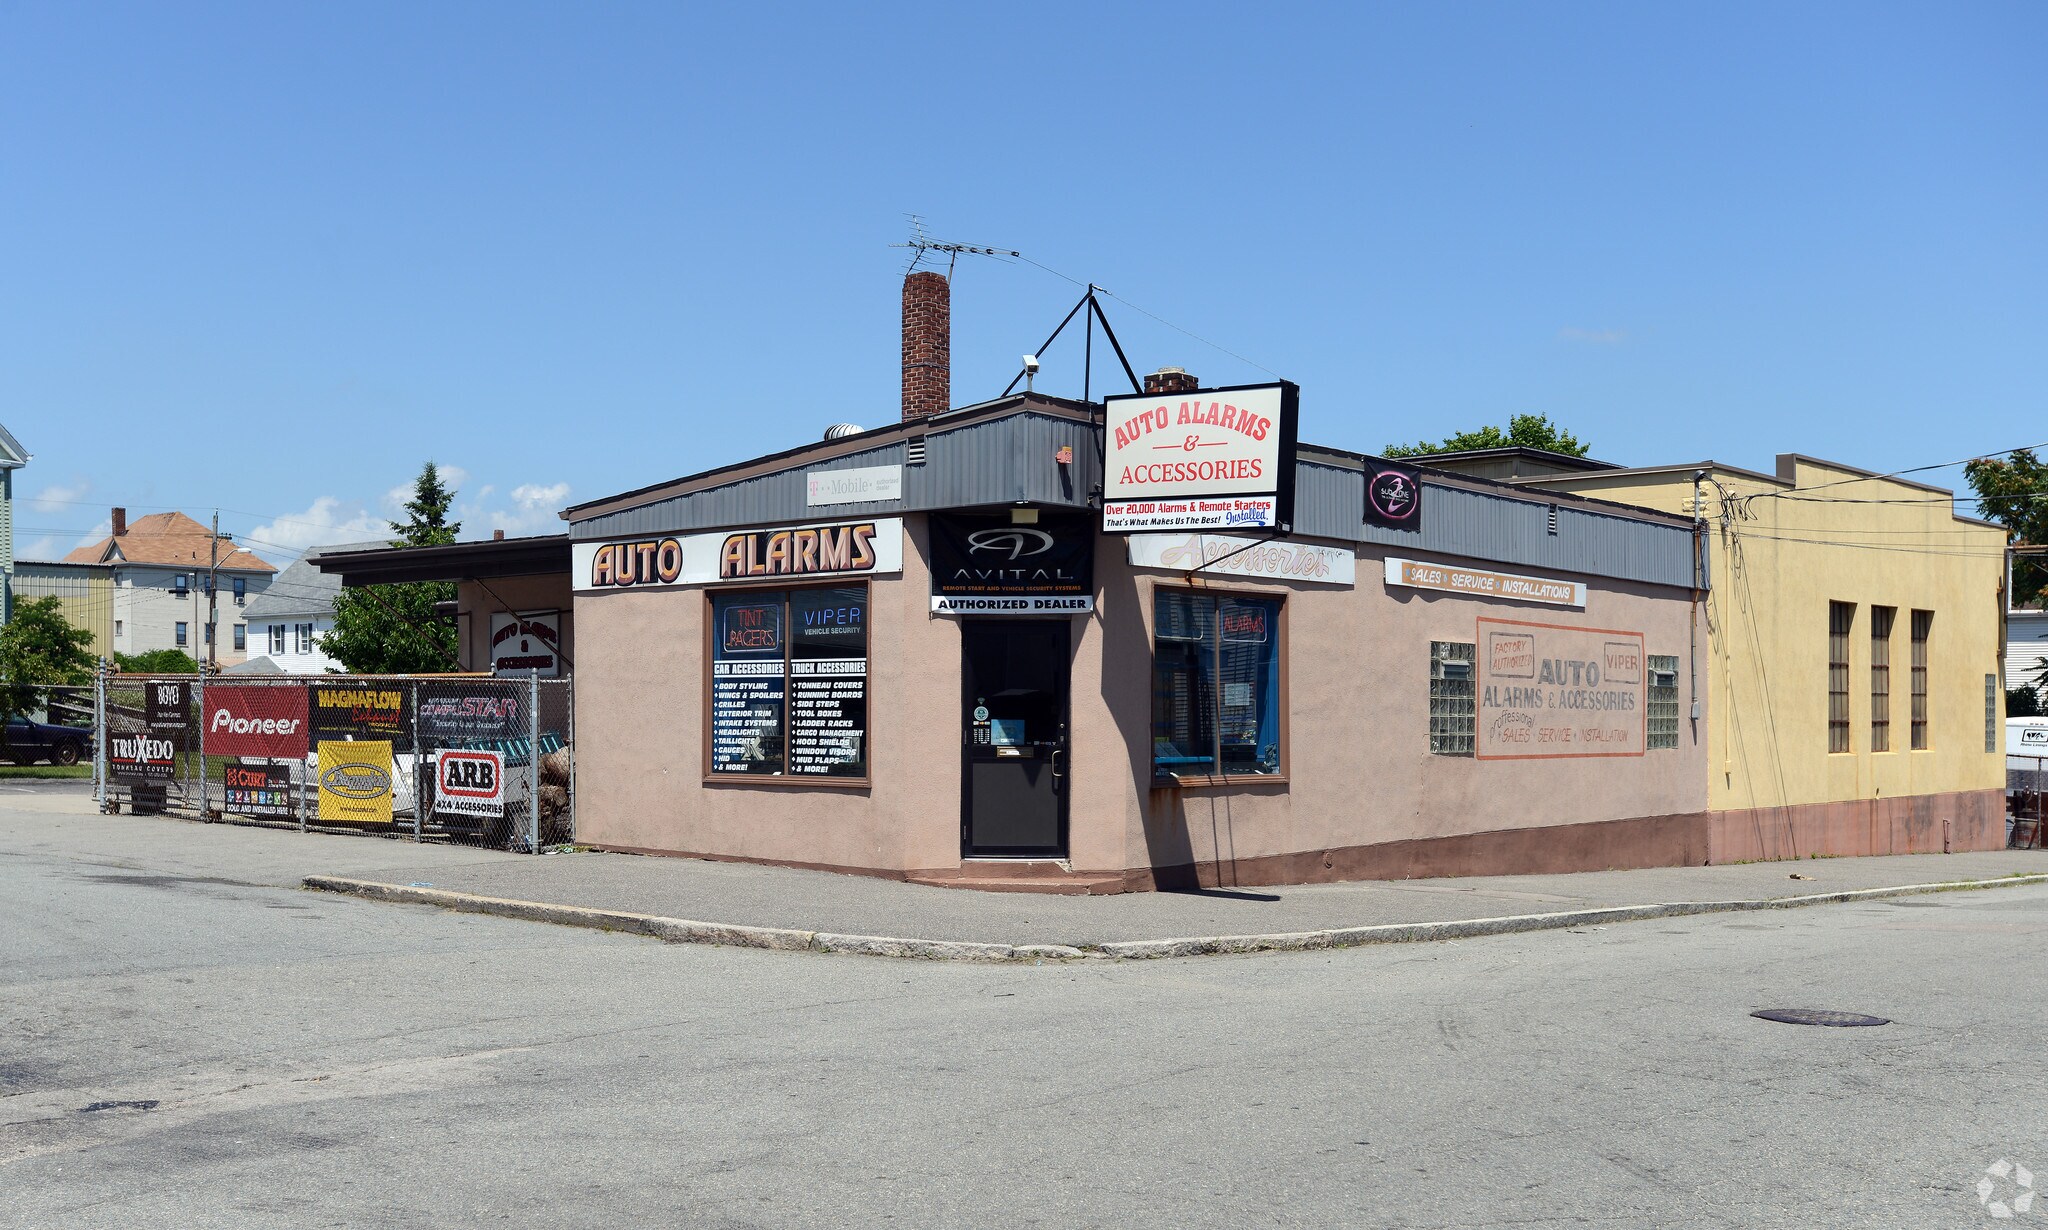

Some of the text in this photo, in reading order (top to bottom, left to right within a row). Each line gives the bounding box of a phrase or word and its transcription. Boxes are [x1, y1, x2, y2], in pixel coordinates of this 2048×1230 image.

[1115, 401, 1271, 450] AUTO ALARMS
[1183, 435, 1199, 451] &
[1120, 459, 1262, 484] ACCESSORIES
[1106, 500, 1271, 515] Over 20,000 Alarms & Remote Starters
[1106, 516, 1221, 527] That's What Makes Us The Best!
[592, 523, 876, 586] AUTO ALARMS
[1160, 534, 1329, 577] Accessories
[954, 569, 1073, 580] AVITAL
[1410, 568, 1570, 599] SALES SERVICE INSTALLATIONS
[938, 599, 1086, 610] AUTHORIZED DEALER
[737, 609, 764, 626] TINT
[805, 608, 860, 625] VIPER
[1224, 615, 1264, 633] ALARMS
[804, 627, 861, 636] VEHICLE SECURITY
[1495, 640, 1527, 654] FACTORY
[714, 663, 785, 674] CAR ACCESSORIES
[791, 662, 866, 673] TRUCK ACCESSORIES
[1492, 654, 1532, 670] AUTHORIZED
[1606, 654, 1638, 670] VIPER
[1538, 659, 1600, 687] AUTO
[739, 682, 768, 690] STYLING
[318, 690, 402, 709] MAGNAFLOW
[750, 691, 784, 699] SPOILERS
[797, 691, 863, 699] RUNNING BOARDS
[1483, 686, 1635, 711] ALARMS & ACCESSORIES
[211, 708, 300, 735] Pioneer
[744, 719, 777, 727] SYSTEMS
[819, 729, 863, 737] MANAGEMENT
[1501, 728, 1629, 743] SALES SERVICE INSTALLATION
[112, 735, 174, 763] TRUXEDO
[828, 748, 857, 756] VISORS
[447, 760, 494, 789] ARB
[804, 765, 829, 773] MORE!
[240, 805, 252, 813] AND
[252, 805, 276, 814] INSTALLED
[437, 801, 503, 814] 4X4 ACCESSORIES
